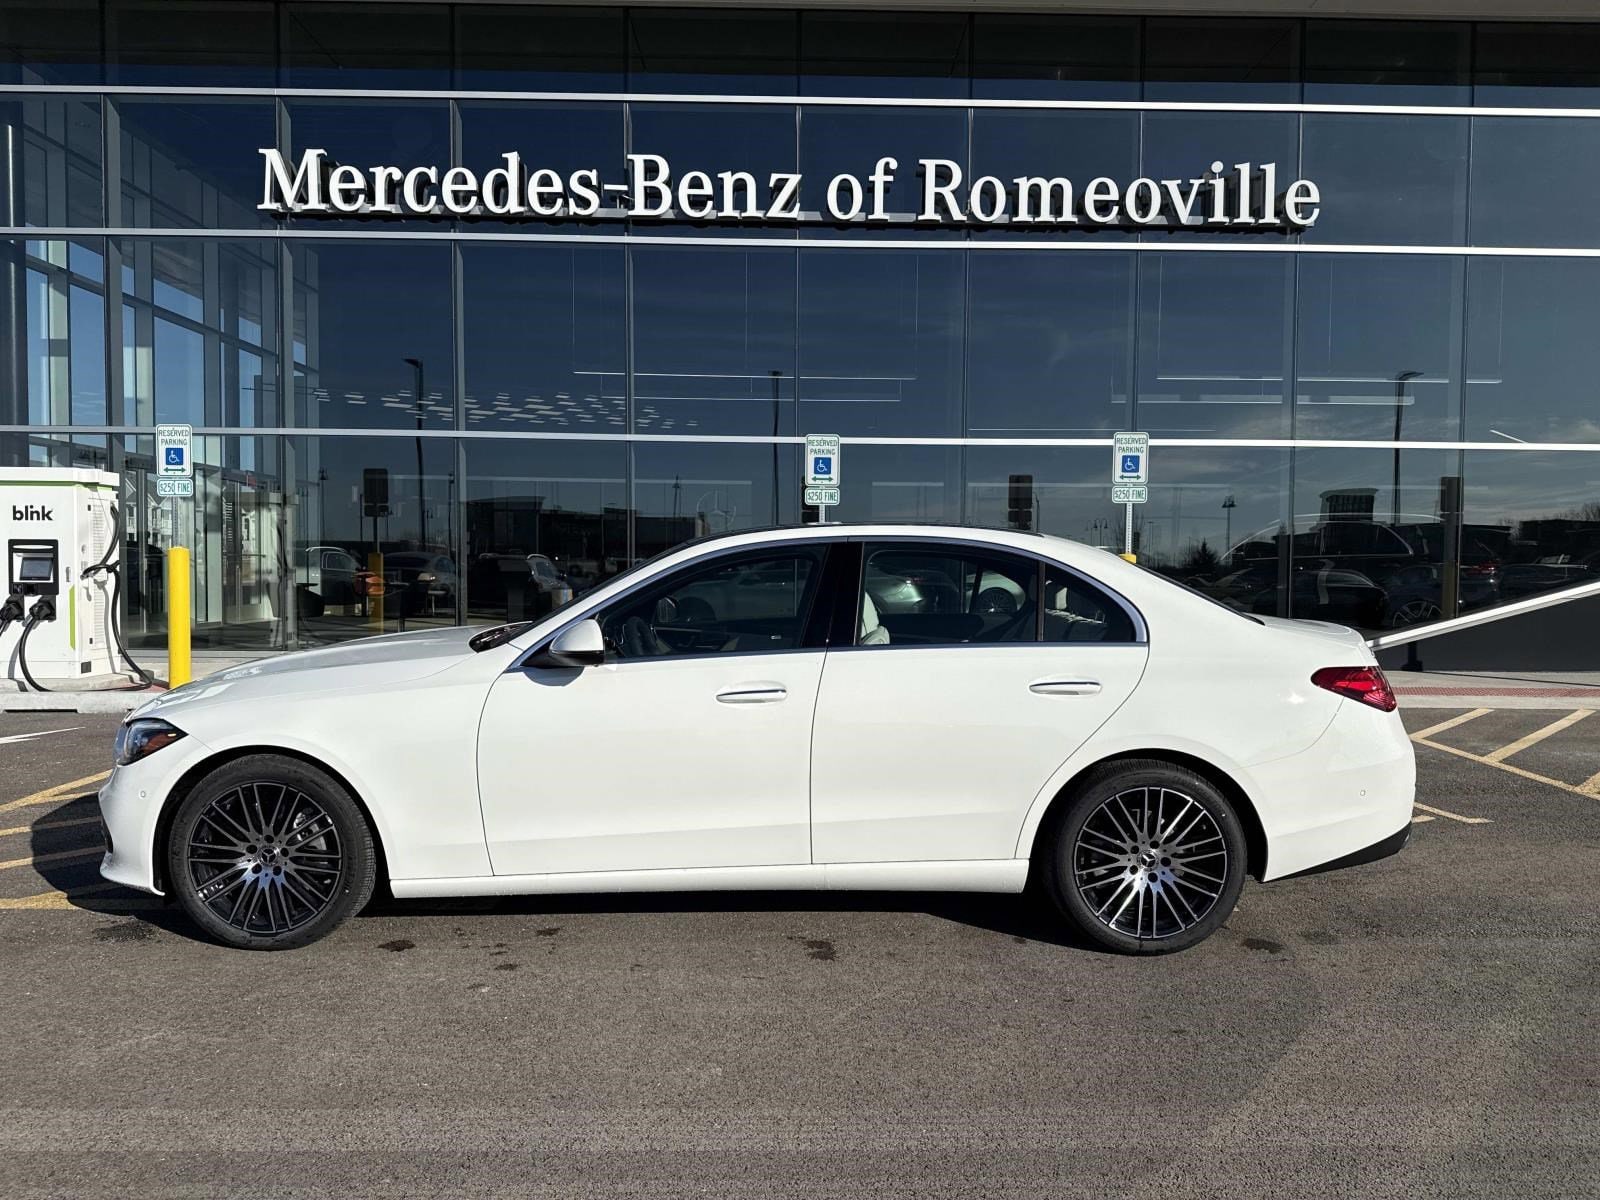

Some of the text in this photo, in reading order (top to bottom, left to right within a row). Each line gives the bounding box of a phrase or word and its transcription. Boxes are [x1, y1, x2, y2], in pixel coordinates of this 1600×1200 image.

[257, 148, 1320, 227] Mercedes-Benz of Romeoville
[161, 438, 188, 446] PARKING
[808, 439, 838, 447] RESERVED
[1116, 437, 1147, 445] RESERVED
[1118, 446, 1144, 454] PARKING
[159, 482, 190, 493] $250 FINE
[807, 491, 837, 501] $250 FINE
[1114, 489, 1145, 500] $250 FINE
[12, 505, 53, 521] blink
